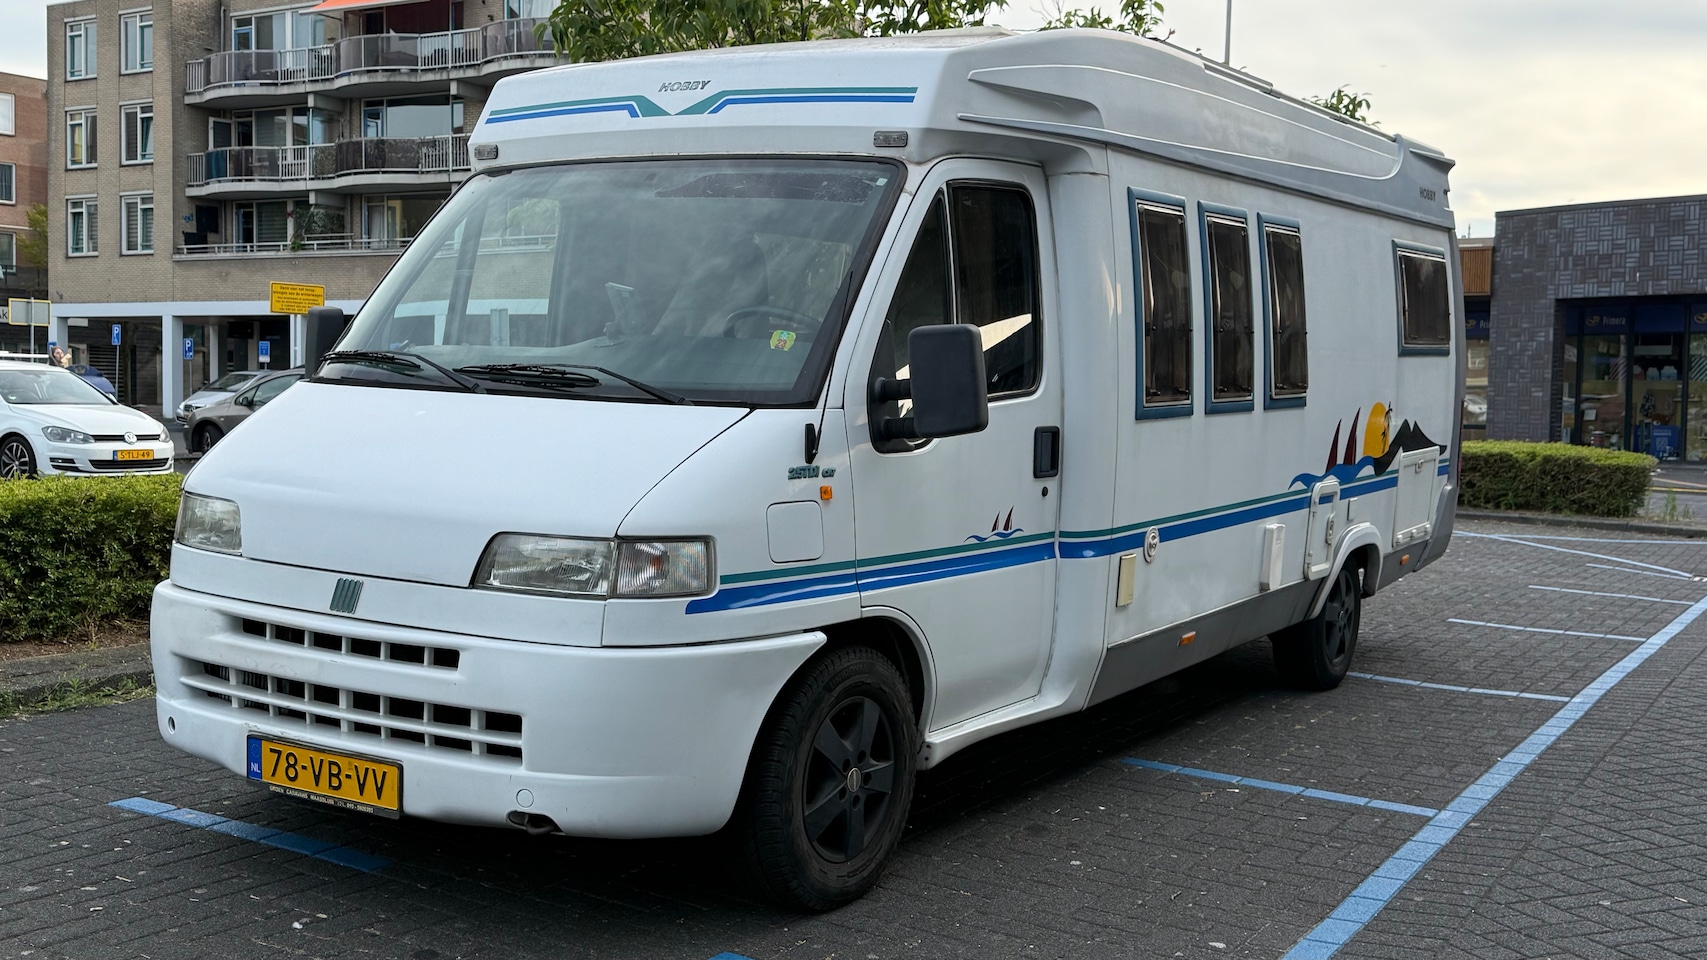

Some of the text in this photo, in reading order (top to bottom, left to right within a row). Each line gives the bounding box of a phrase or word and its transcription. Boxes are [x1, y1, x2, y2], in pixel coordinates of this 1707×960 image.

[658, 80, 712, 93] HOBBY
[1602, 315, 1626, 326] Primera
[120, 451, 150, 459] 5-TLJ-49
[250, 761, 261, 773] NL
[269, 747, 388, 800] 78-VB-VV
